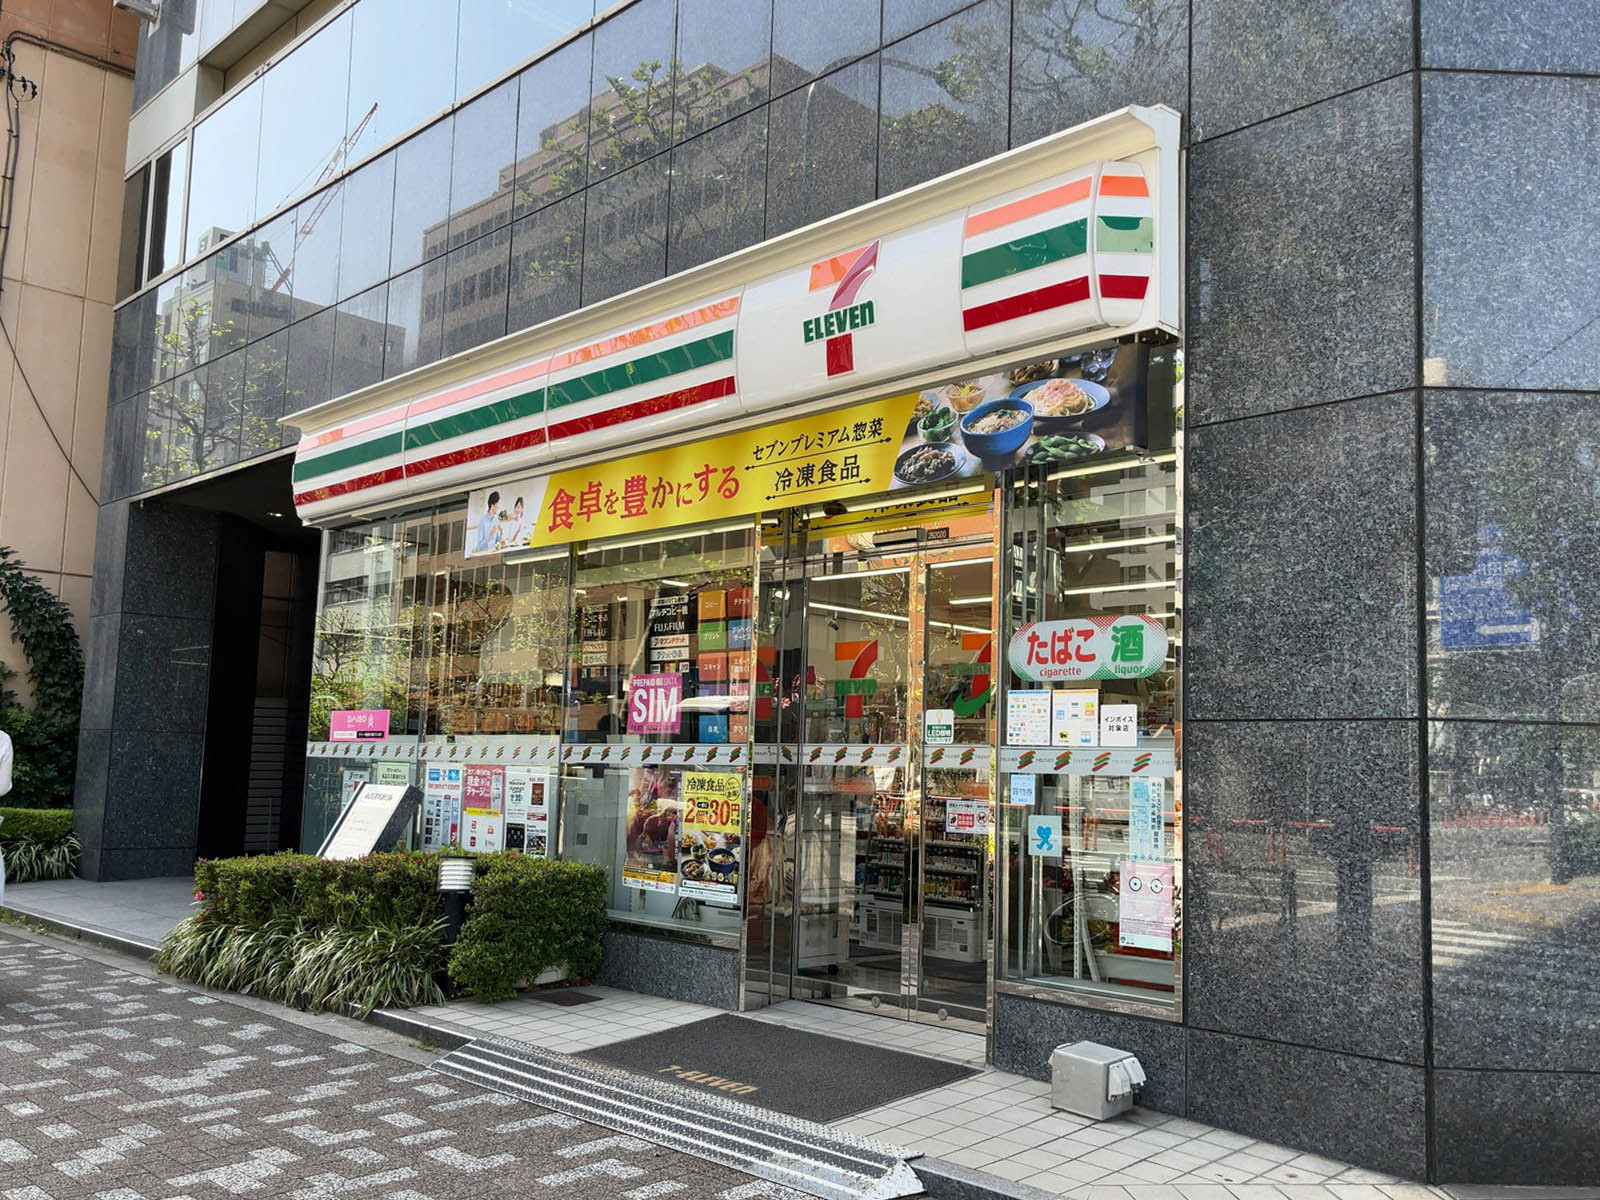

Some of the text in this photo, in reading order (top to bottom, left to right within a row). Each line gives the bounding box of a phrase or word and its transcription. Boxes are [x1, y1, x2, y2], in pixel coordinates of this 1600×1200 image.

[752, 417, 884, 462] セブンプレミアム惣菜
[775, 454, 860, 492] 冷凍食品
[547, 463, 740, 534] 食卓を豊かにする
[1027, 624, 1144, 666] たばこ 酒
[1039, 664, 1145, 678] cigarette liquor
[632, 688, 678, 723] SIM
[1103, 715, 1134, 723] インボイス
[1108, 725, 1129, 733] 対象店
[686, 777, 725, 792] 冷凍食品
